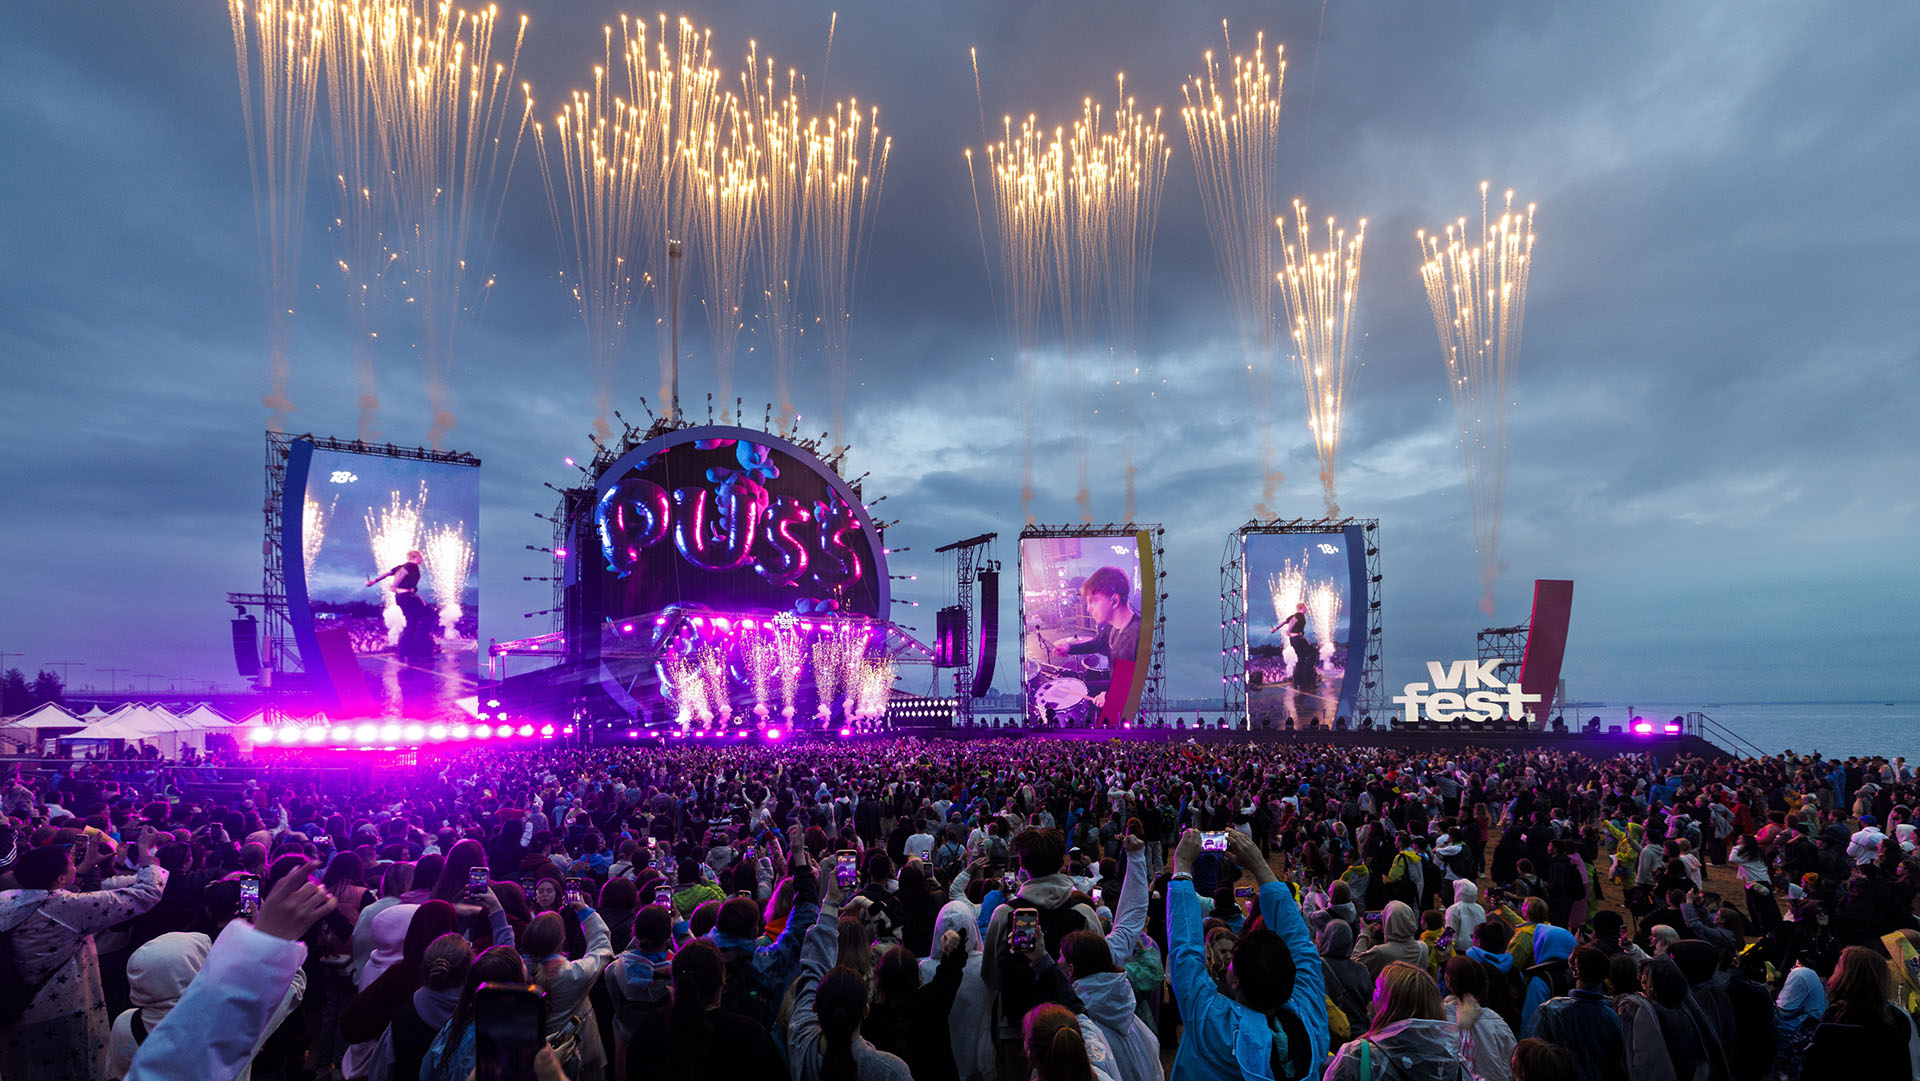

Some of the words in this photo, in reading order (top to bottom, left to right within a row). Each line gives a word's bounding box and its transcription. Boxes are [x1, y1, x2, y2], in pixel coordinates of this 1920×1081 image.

[330, 471, 358, 483] 18+
[1111, 545, 1129, 554] 18+
[1317, 544, 1339, 554] 18+
[1426, 658, 1507, 689] VK
[1392, 682, 1542, 722] fest
